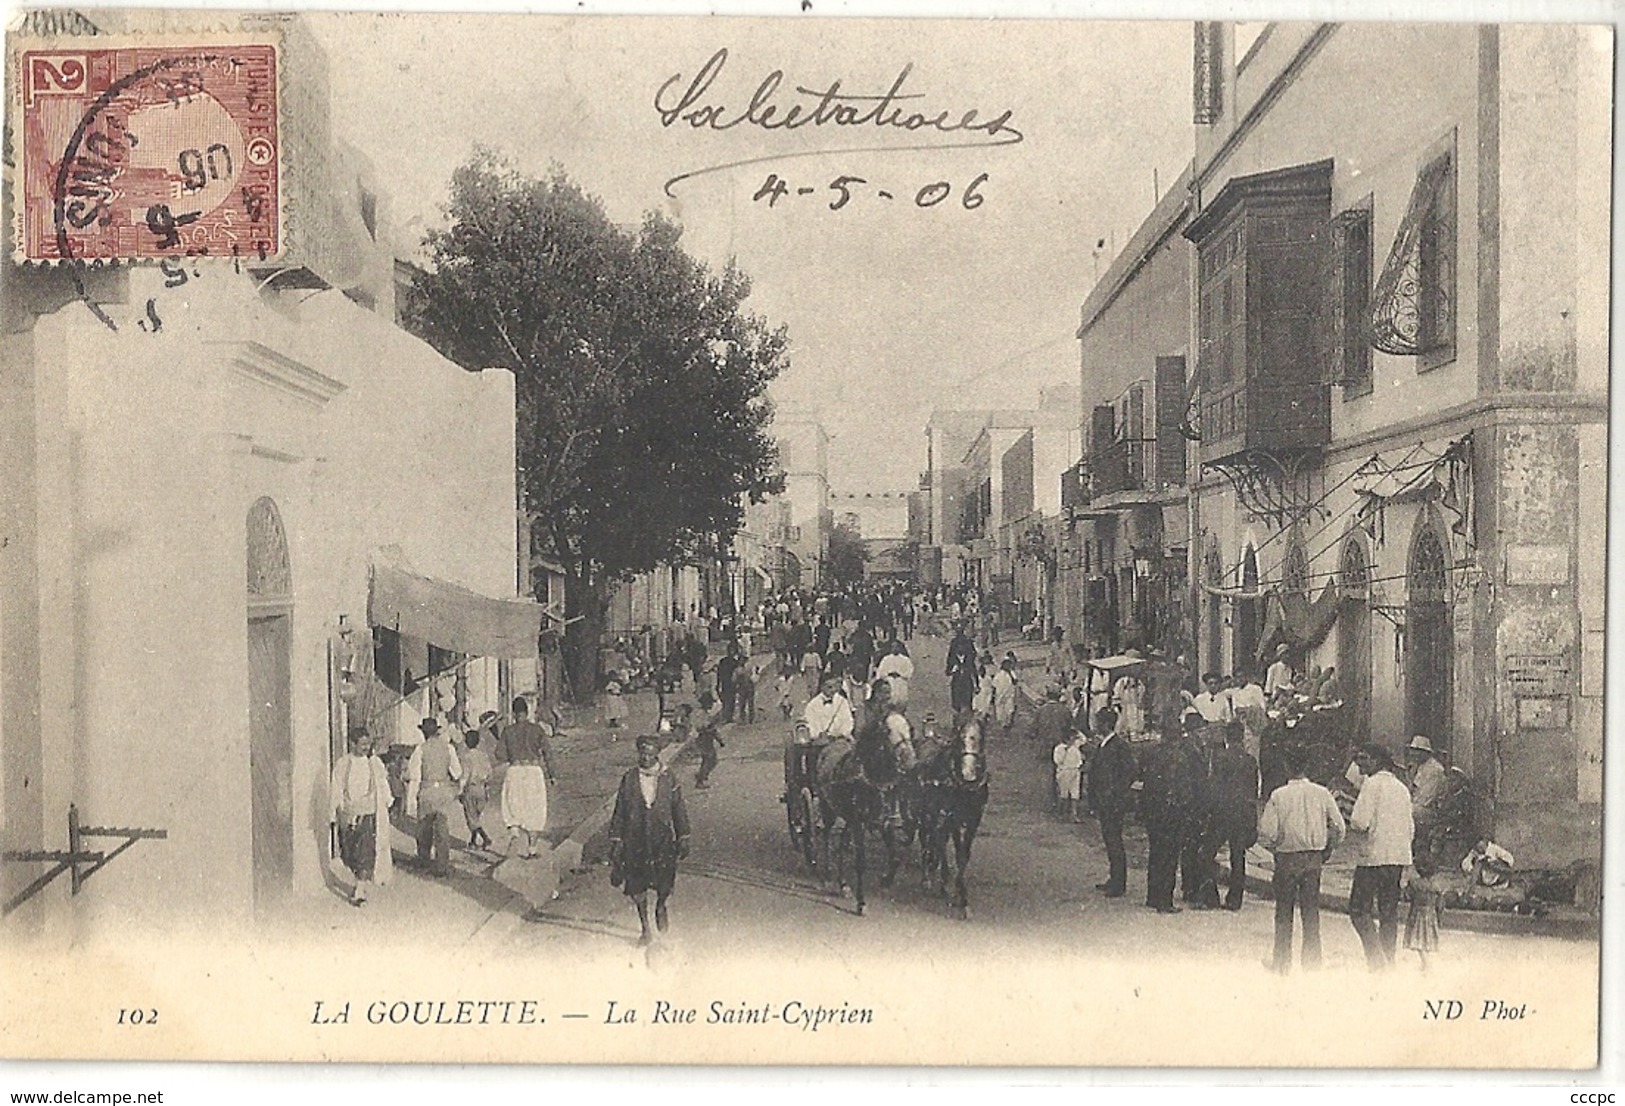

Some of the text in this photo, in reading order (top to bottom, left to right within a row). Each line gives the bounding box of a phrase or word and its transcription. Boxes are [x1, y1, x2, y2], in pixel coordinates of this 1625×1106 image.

[32, 59, 84, 90] 2
[246, 55, 271, 135] TUNISIE
[248, 169, 273, 252] POSTES
[117, 1008, 159, 1025] 102
[310, 1001, 351, 1025] LA
[367, 1000, 546, 1025] GOULETTE.
[603, 1001, 637, 1025] La
[651, 1000, 697, 1025] Rue
[706, 1000, 874, 1032] Saint-Cyprien
[1422, 1000, 1464, 1021] ND
